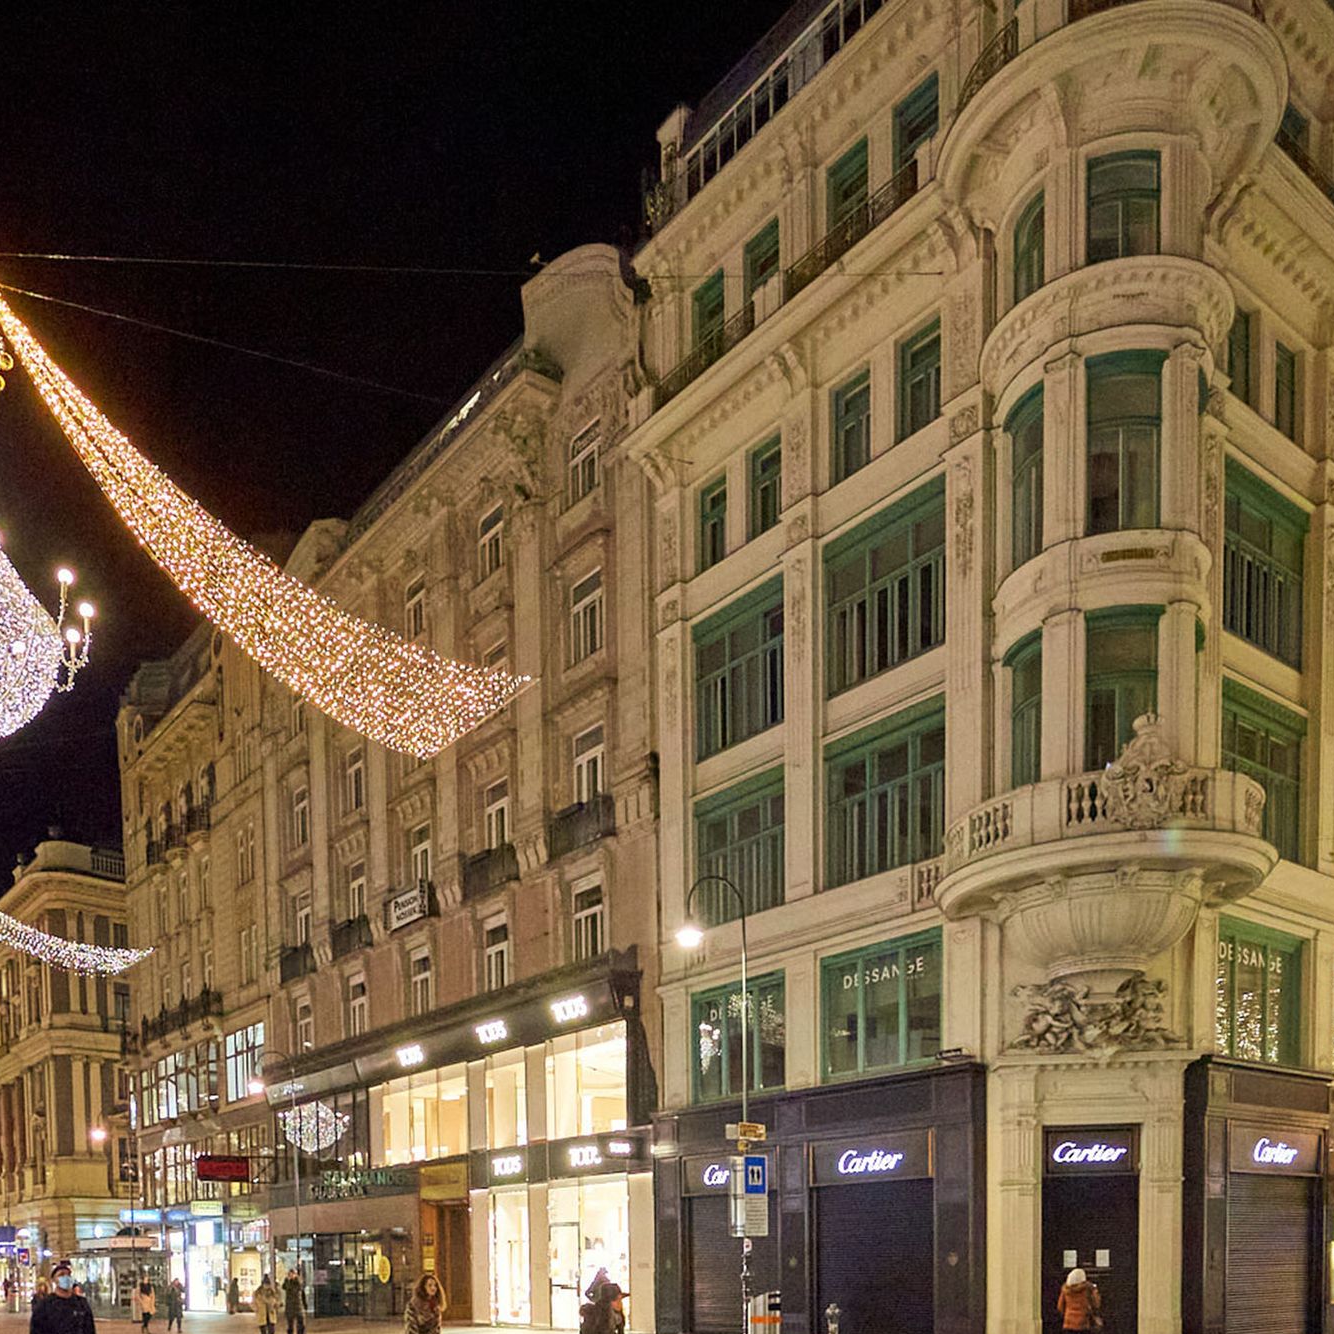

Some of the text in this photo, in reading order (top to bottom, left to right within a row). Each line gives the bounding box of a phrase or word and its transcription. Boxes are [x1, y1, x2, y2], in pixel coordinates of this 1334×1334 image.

[838, 1150, 904, 1174] Cartier
[1052, 1141, 1128, 1163] Cartier
[1252, 1137, 1298, 1164] Cartier
